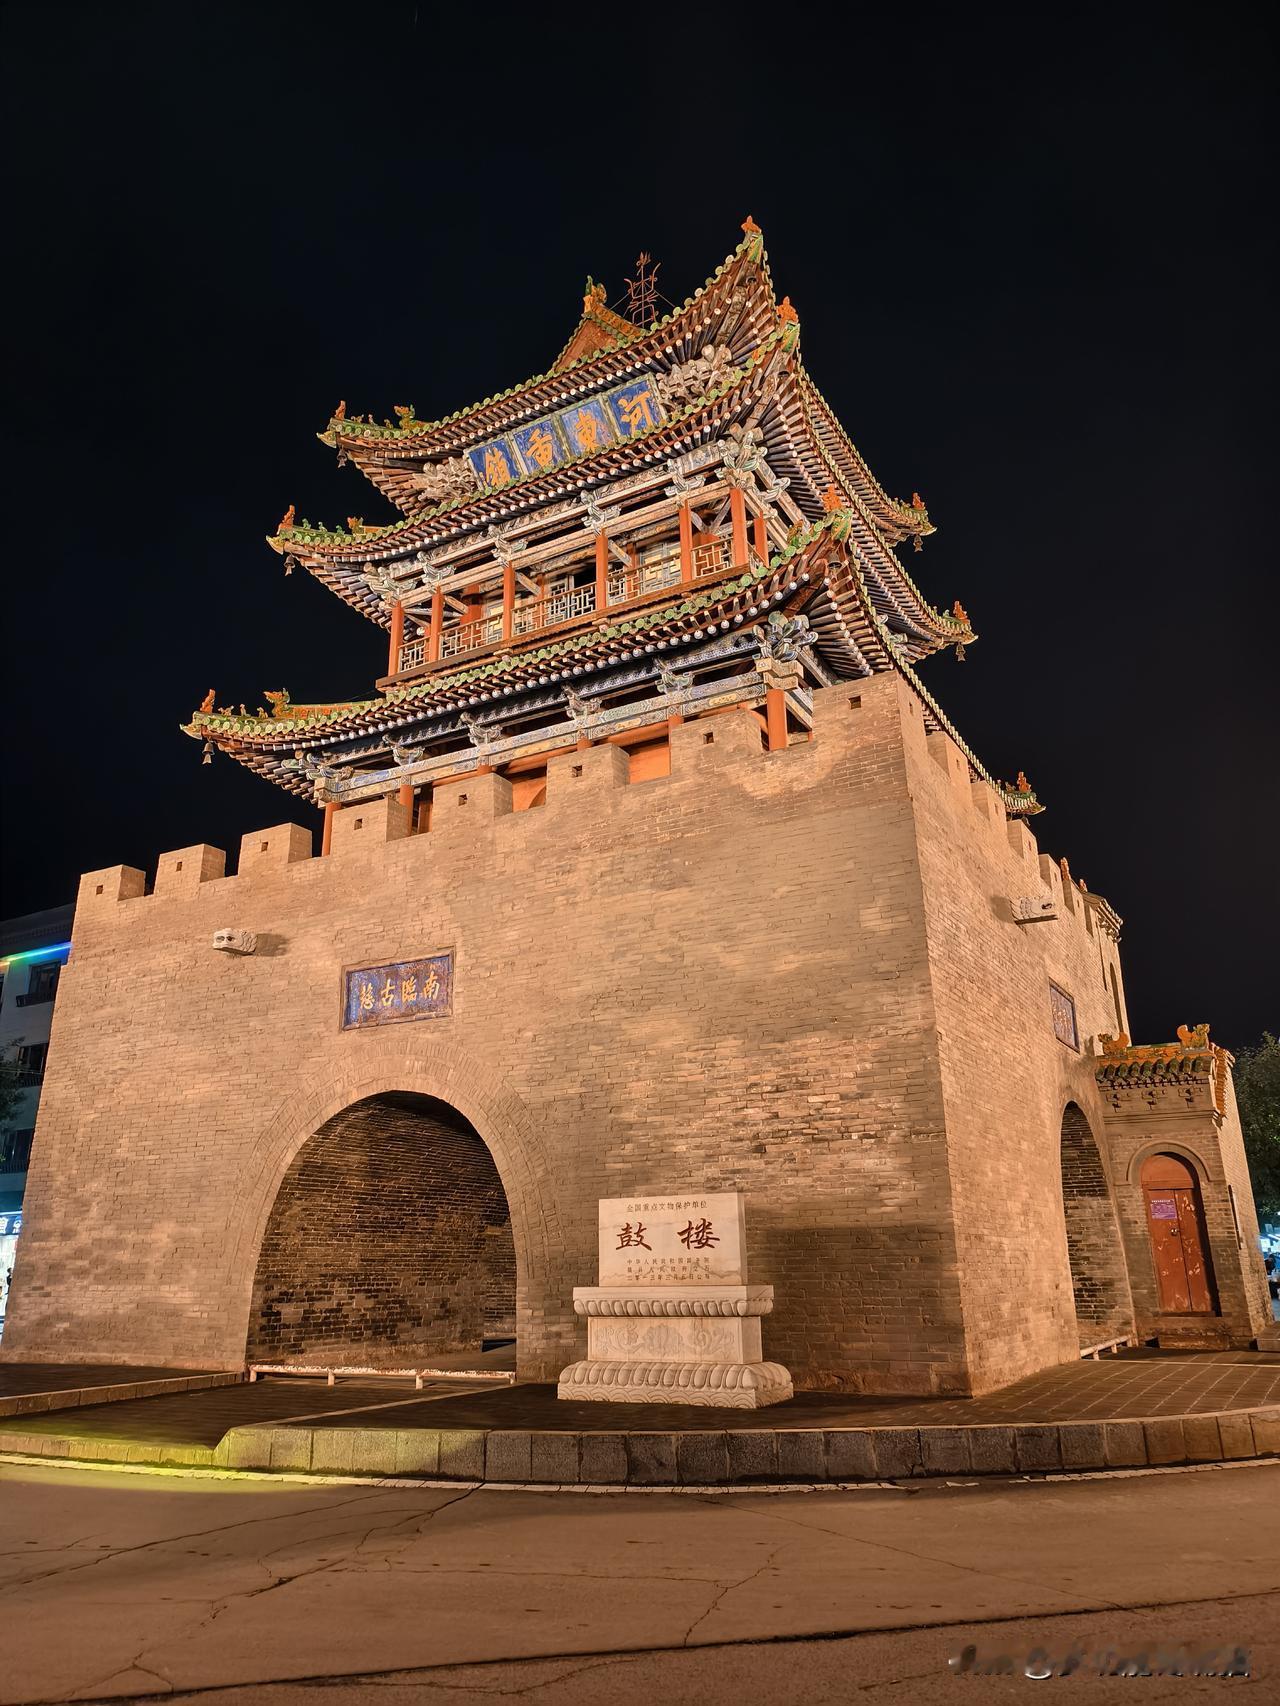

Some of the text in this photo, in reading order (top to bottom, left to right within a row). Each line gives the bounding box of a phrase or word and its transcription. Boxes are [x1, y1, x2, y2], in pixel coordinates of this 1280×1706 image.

[627, 1200, 708, 1213] 全国重点文物保护单位
[615, 1217, 720, 1251] 鼓楼
